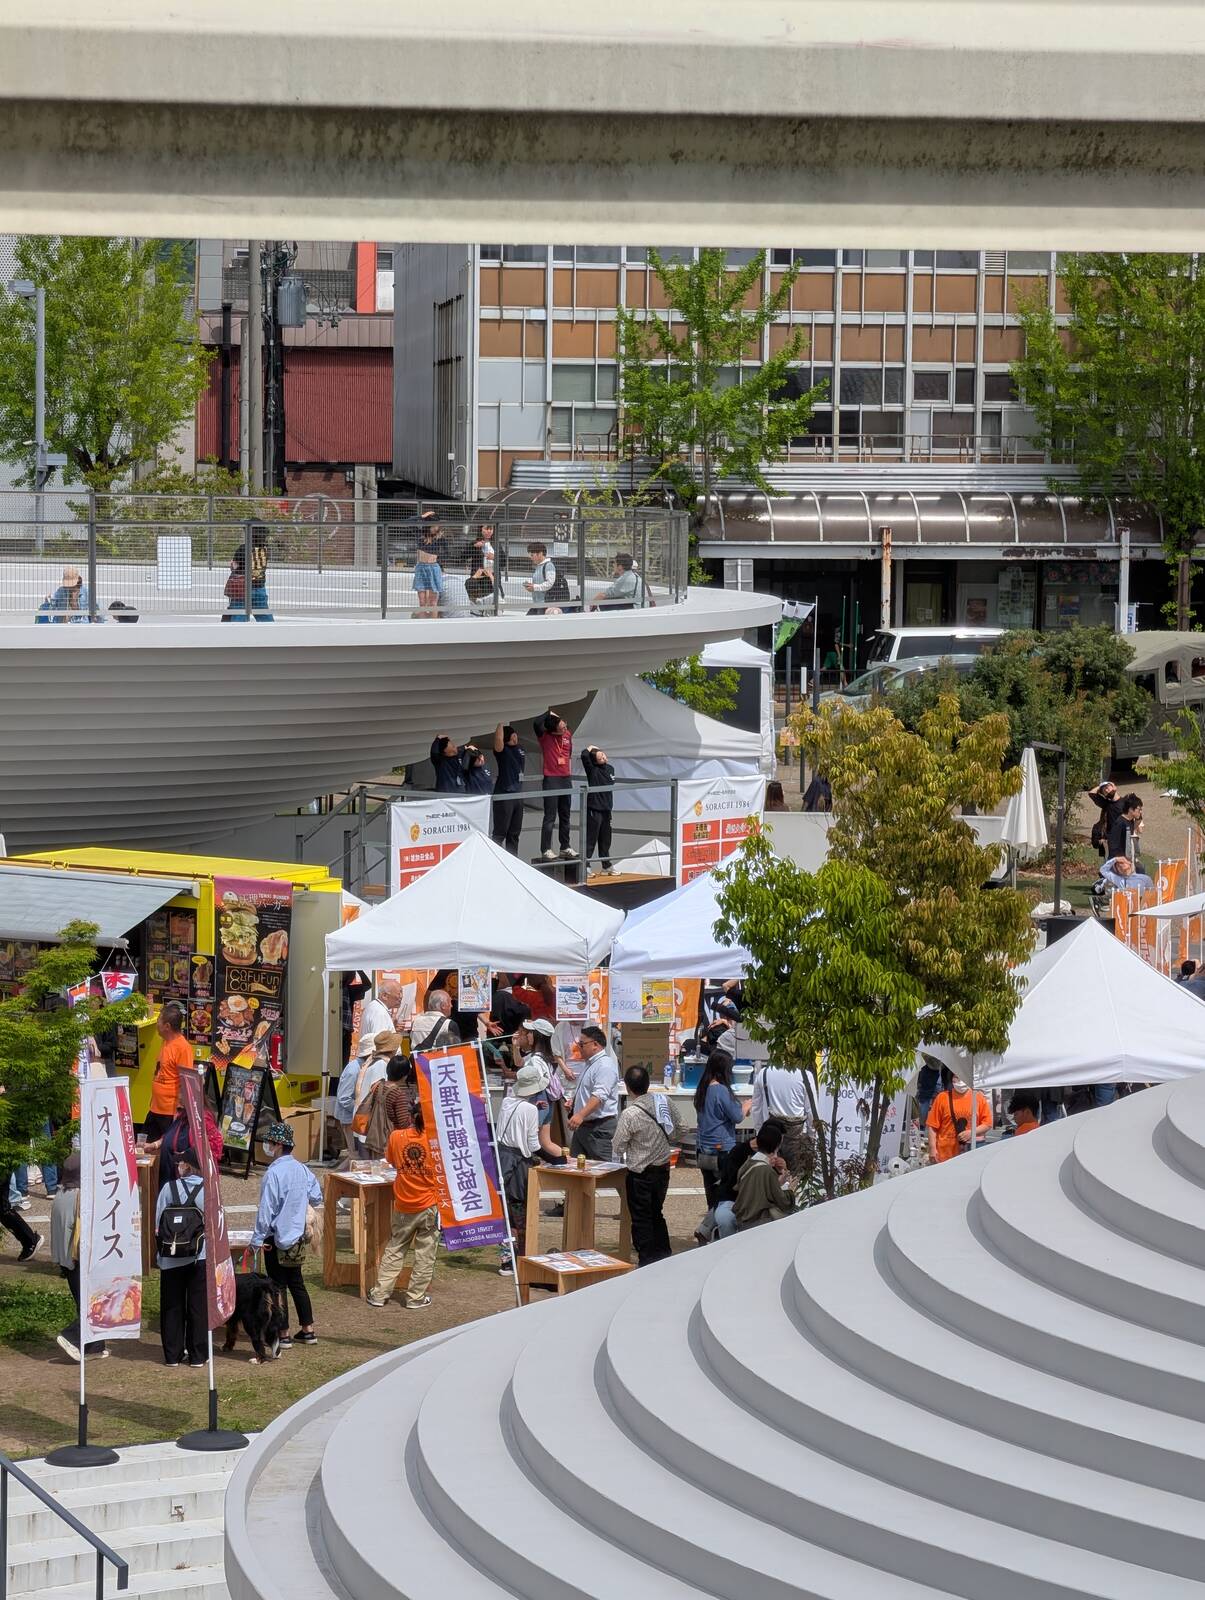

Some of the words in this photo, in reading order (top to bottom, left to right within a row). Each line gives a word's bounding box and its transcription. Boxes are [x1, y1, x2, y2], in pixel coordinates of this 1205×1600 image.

[705, 801, 733, 811] SORACHI
[422, 824, 455, 836] SORACHI
[122, 1111, 135, 1155] ふわとろ
[96, 1105, 123, 1261] オムライス
